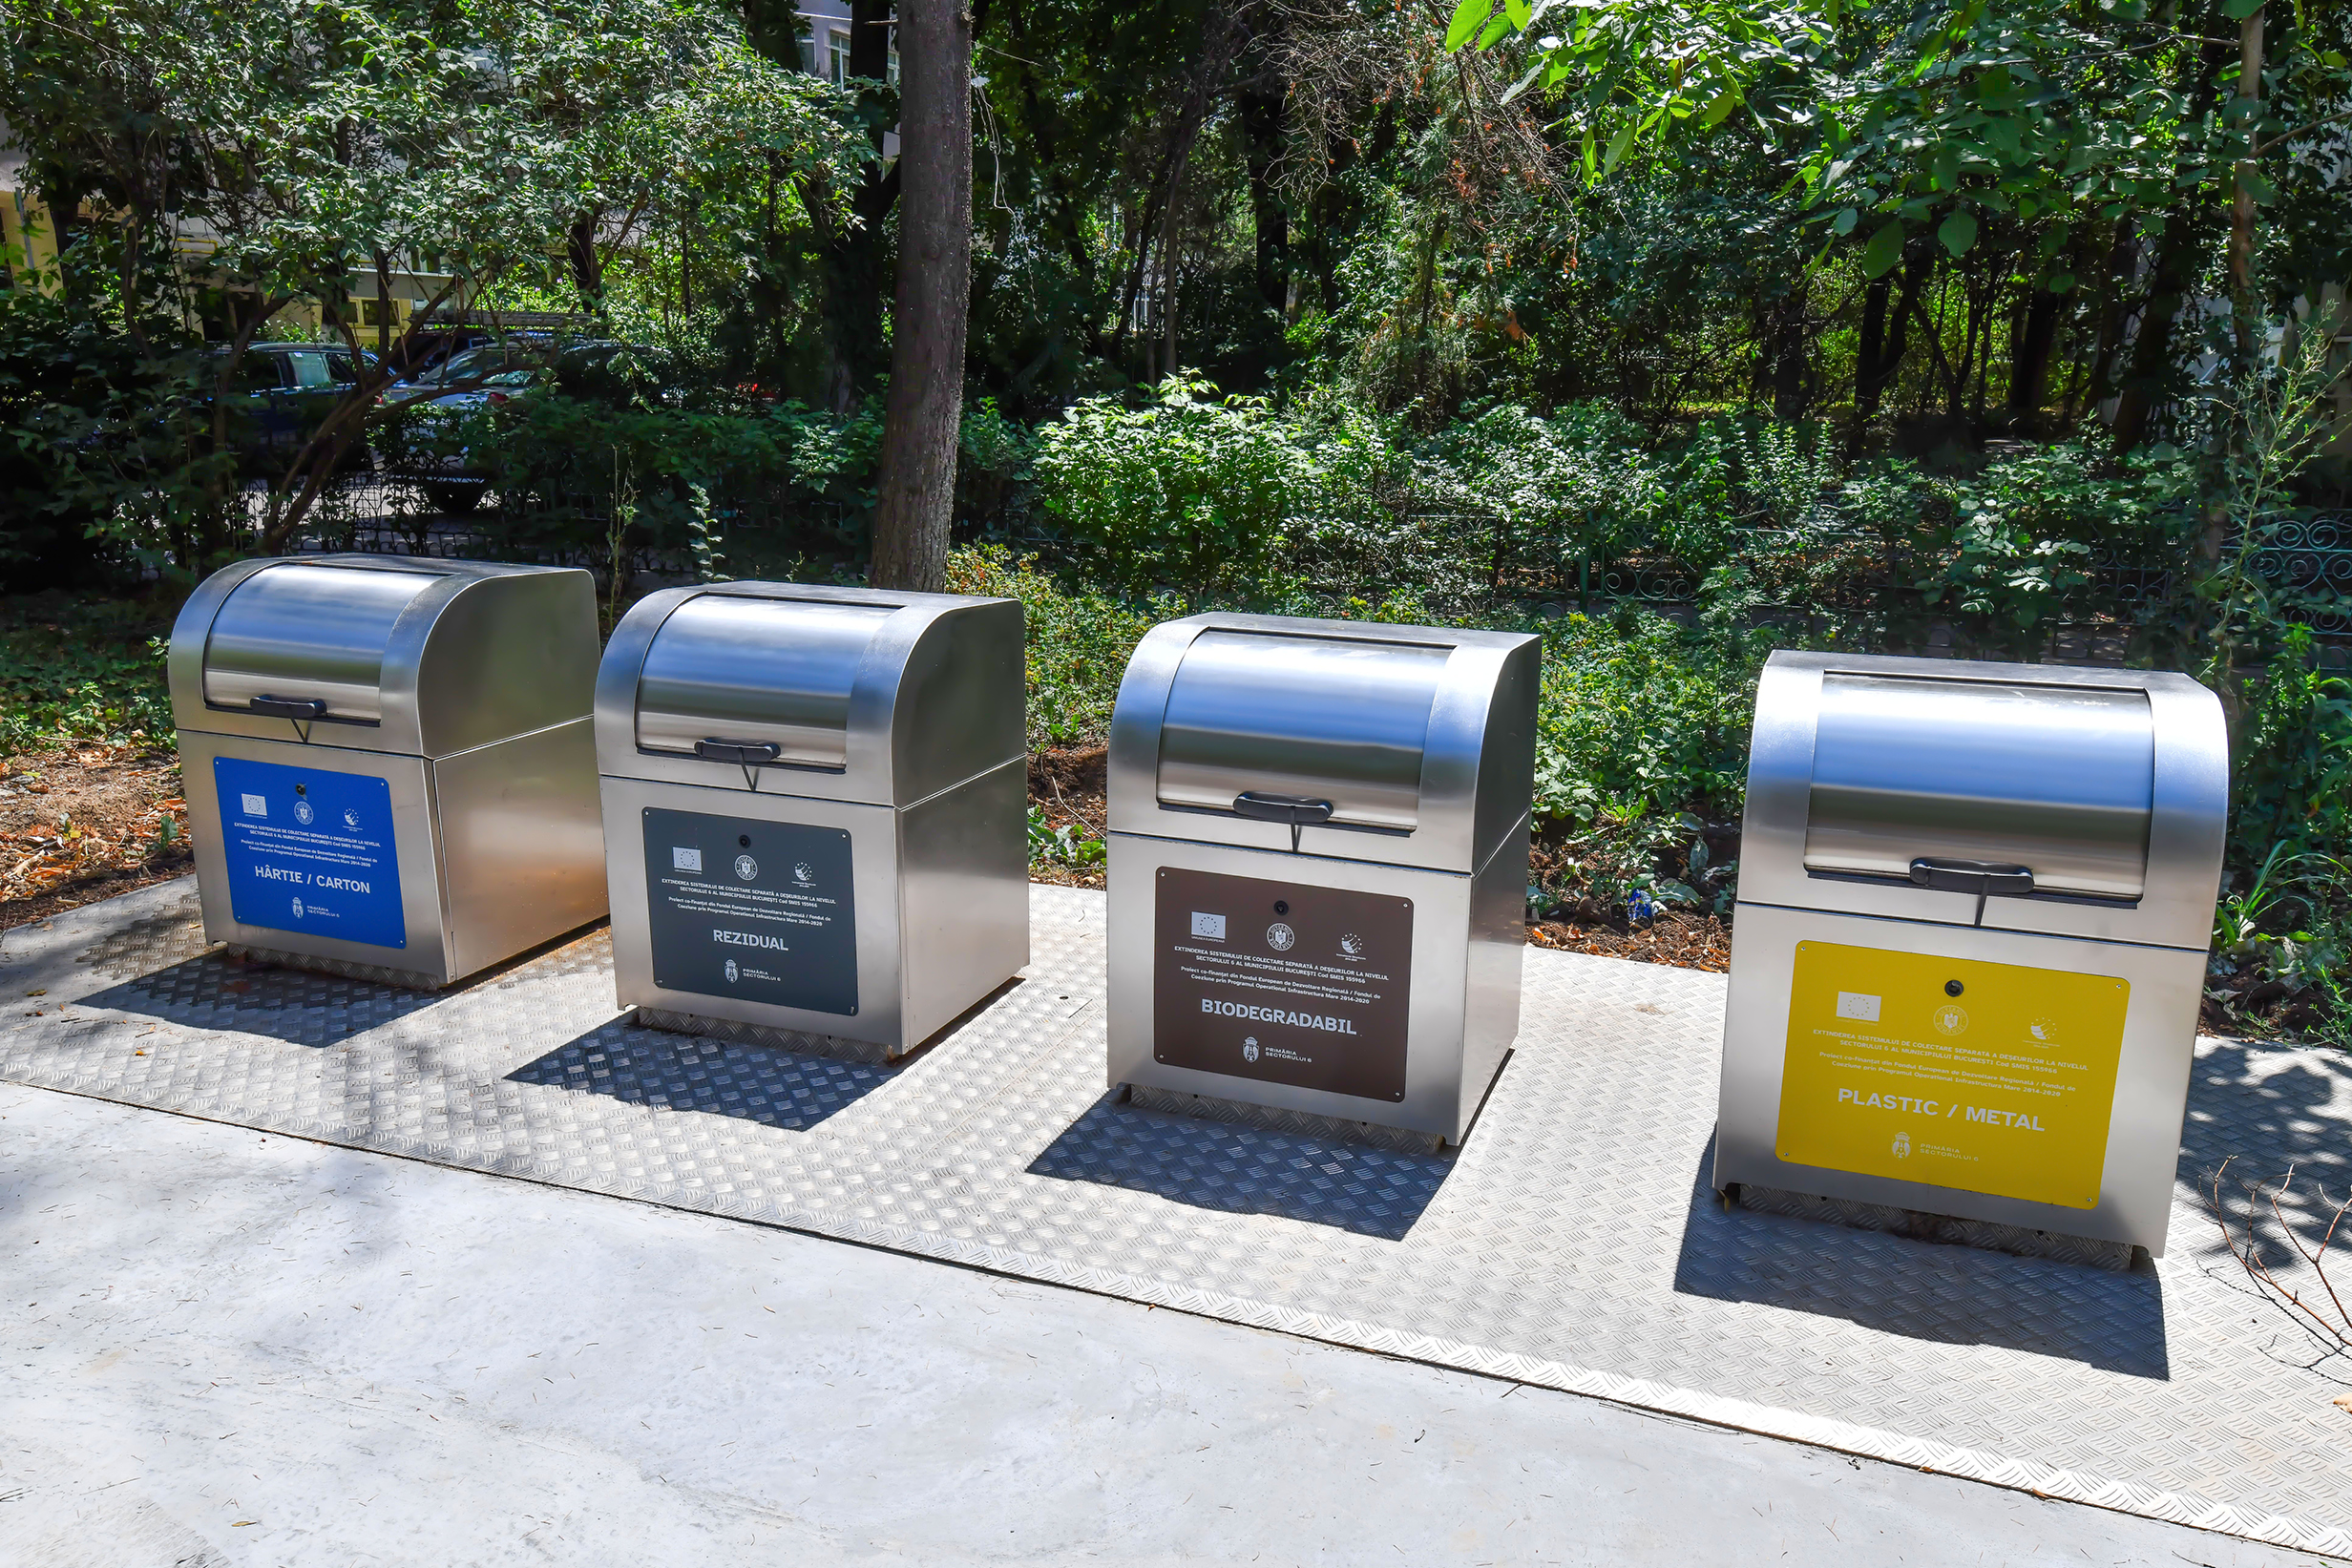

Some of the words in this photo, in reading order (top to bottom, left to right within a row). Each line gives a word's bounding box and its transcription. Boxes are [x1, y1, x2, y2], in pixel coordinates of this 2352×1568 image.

[254, 863, 304, 884] HÂRTIE
[306, 873, 312, 885] /
[316, 875, 370, 894] CARTON
[713, 929, 788, 951] REZIDUAL
[1175, 946, 1208, 955] EXTINDEREA
[1209, 951, 1242, 960] SISTEMULUI
[1252, 956, 1283, 966] COLECTARE
[1196, 955, 1228, 965] SECTORULUI
[1244, 962, 1283, 972] MUNICIPIULUI
[1191, 973, 1214, 982] Coeziune
[1228, 979, 1253, 988] Programul
[1287, 988, 1323, 997] Infrastructura
[1340, 995, 1370, 1004] 2014-2020
[1258, 977, 1282, 986] European
[1292, 982, 1320, 991] Dezvoltare
[1202, 998, 1357, 1035] BIODEGRADABIL
[1266, 1052, 1307, 1062] SECTORULUI
[1814, 1029, 1856, 1039] EXTINDEREA
[1858, 1035, 1900, 1046] SISTEMULUI
[1913, 1042, 1953, 1053] COLECTARE
[2057, 1061, 2089, 1071] NIVELUL
[1840, 1040, 1882, 1051] SECTORULUI
[1901, 1048, 1952, 1060] MUNICIPIULUI
[2032, 1066, 2058, 1075] 155966
[1819, 1052, 1843, 1060] Proiect
[1919, 1065, 1949, 1076] European
[1962, 1071, 1998, 1081] Dezvoltare
[2041, 1081, 2065, 1090] Fondul
[1832, 1060, 1861, 1070] Coeziune
[1879, 1067, 1912, 1077] Programul
[1955, 1077, 2002, 1089] Infrastructura
[2023, 1087, 2061, 1098] 2014-2020
[1838, 1088, 1939, 1117] PLASTIC
[1946, 1103, 1958, 1119] /
[1965, 1106, 2047, 1132] METAL
[1920, 1148, 1972, 1160] SECTORULUI
